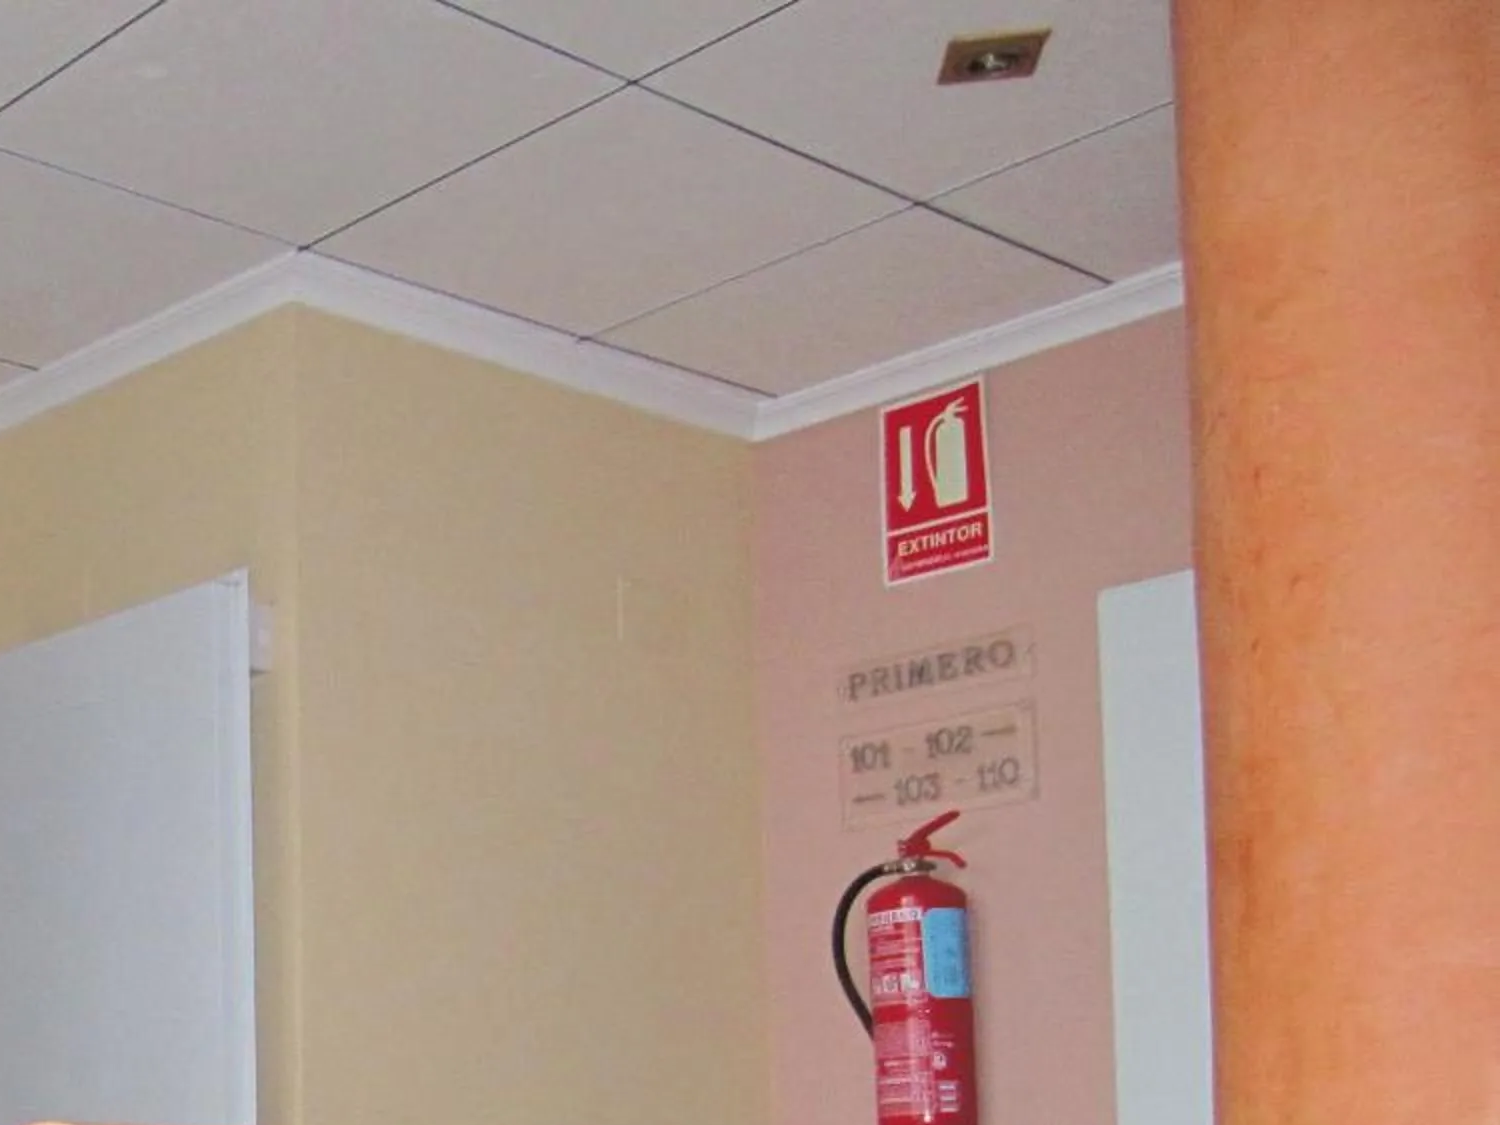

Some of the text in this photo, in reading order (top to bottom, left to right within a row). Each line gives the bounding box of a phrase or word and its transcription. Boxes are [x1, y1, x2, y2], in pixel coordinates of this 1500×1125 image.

[898, 521, 983, 557] EXTINTOR
[848, 639, 1015, 702] PRIMERO
[851, 725, 973, 773] 101 102
[894, 756, 1020, 806] 103 110
